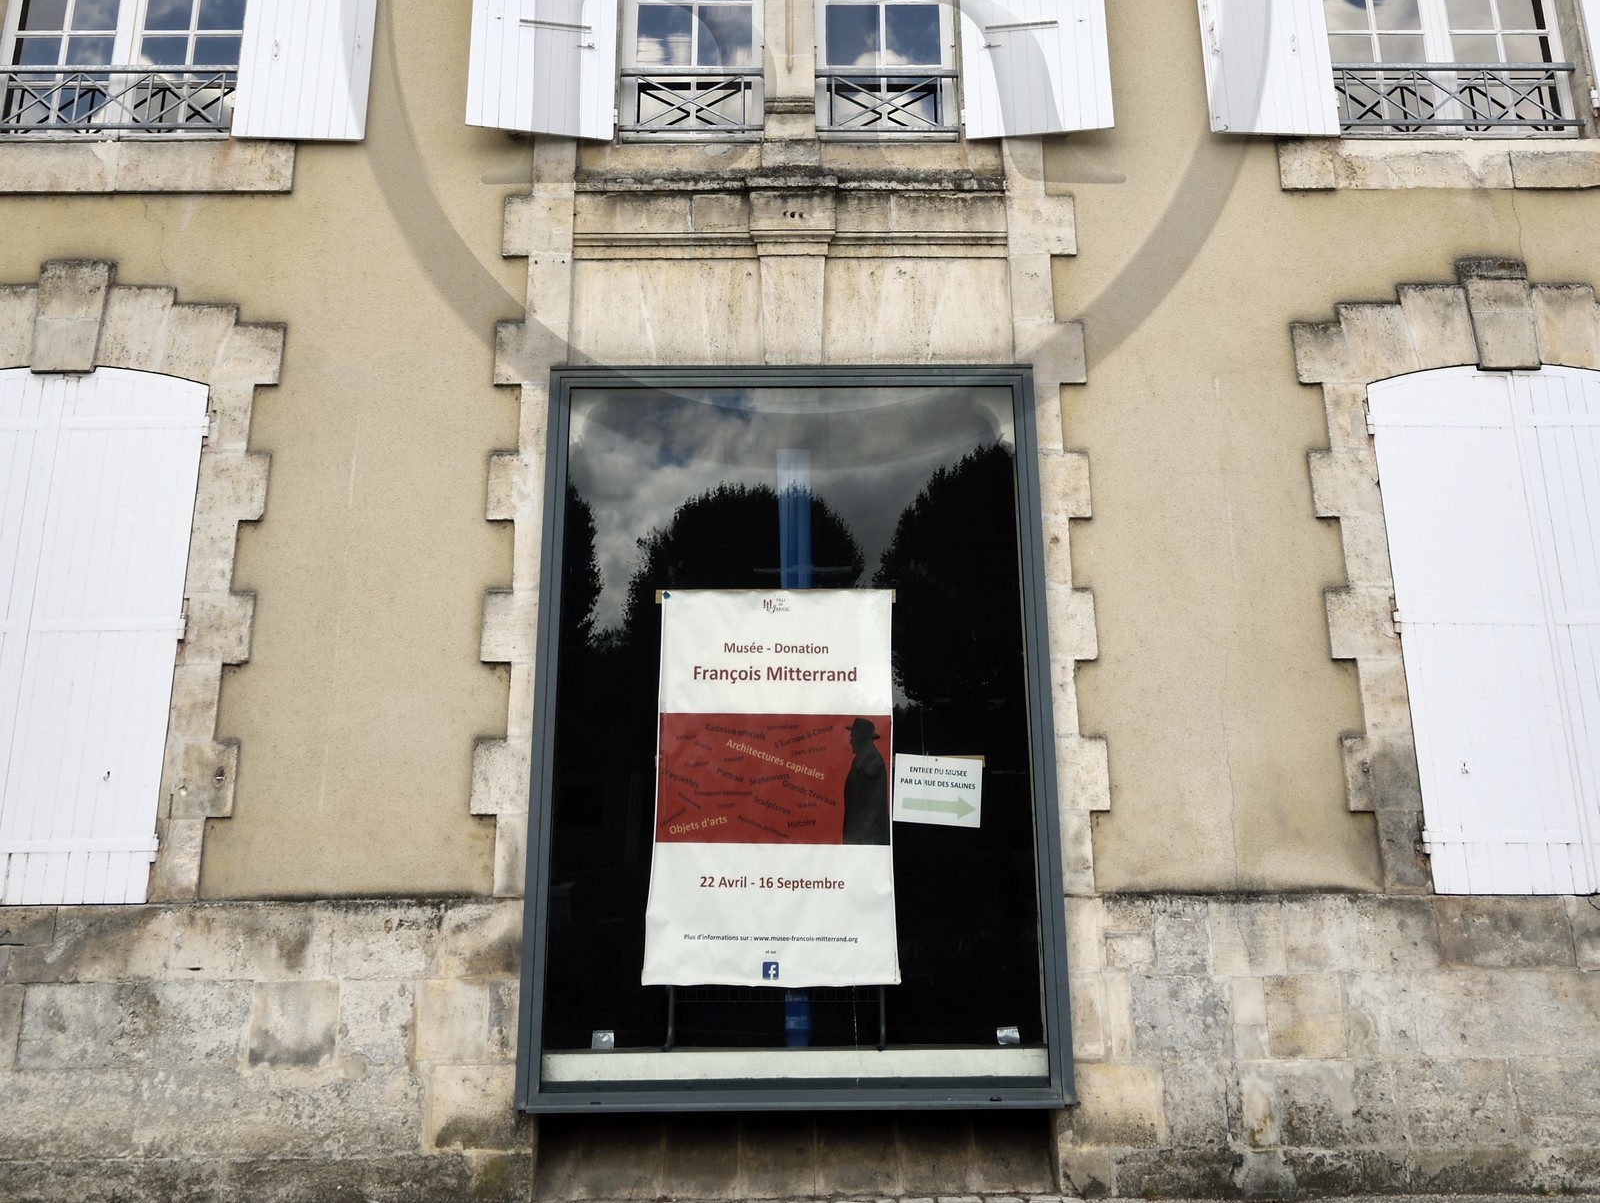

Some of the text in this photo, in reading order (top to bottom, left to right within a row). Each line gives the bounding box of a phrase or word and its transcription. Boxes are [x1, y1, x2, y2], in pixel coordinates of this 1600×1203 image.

[724, 642, 763, 654] Musée
[774, 643, 829, 654] Donation
[693, 666, 858, 684] François Mitterrand
[705, 723, 766, 740] Cadeaux officiels
[774, 734, 806, 748] L'Europe
[812, 725, 833, 736] Coeur
[726, 739, 825, 780] Architectures capitales
[716, 767, 744, 783] Portrait
[749, 773, 790, 785] Septennats
[909, 766, 933, 774] ENTREE
[945, 769, 967, 777] MUSEE
[900, 777, 913, 785] PAR
[782, 780, 837, 806] Grands Travaux
[753, 796, 790, 815] Sculptures
[669, 816, 728, 834] Objets d'arts
[787, 818, 817, 829] Histoire
[700, 876, 715, 888] 22
[718, 876, 747, 888] Avril
[759, 877, 774, 889] 16
[777, 877, 845, 891] Septembre
[753, 935, 858, 944] www.musee-francois-mitterrand.org
